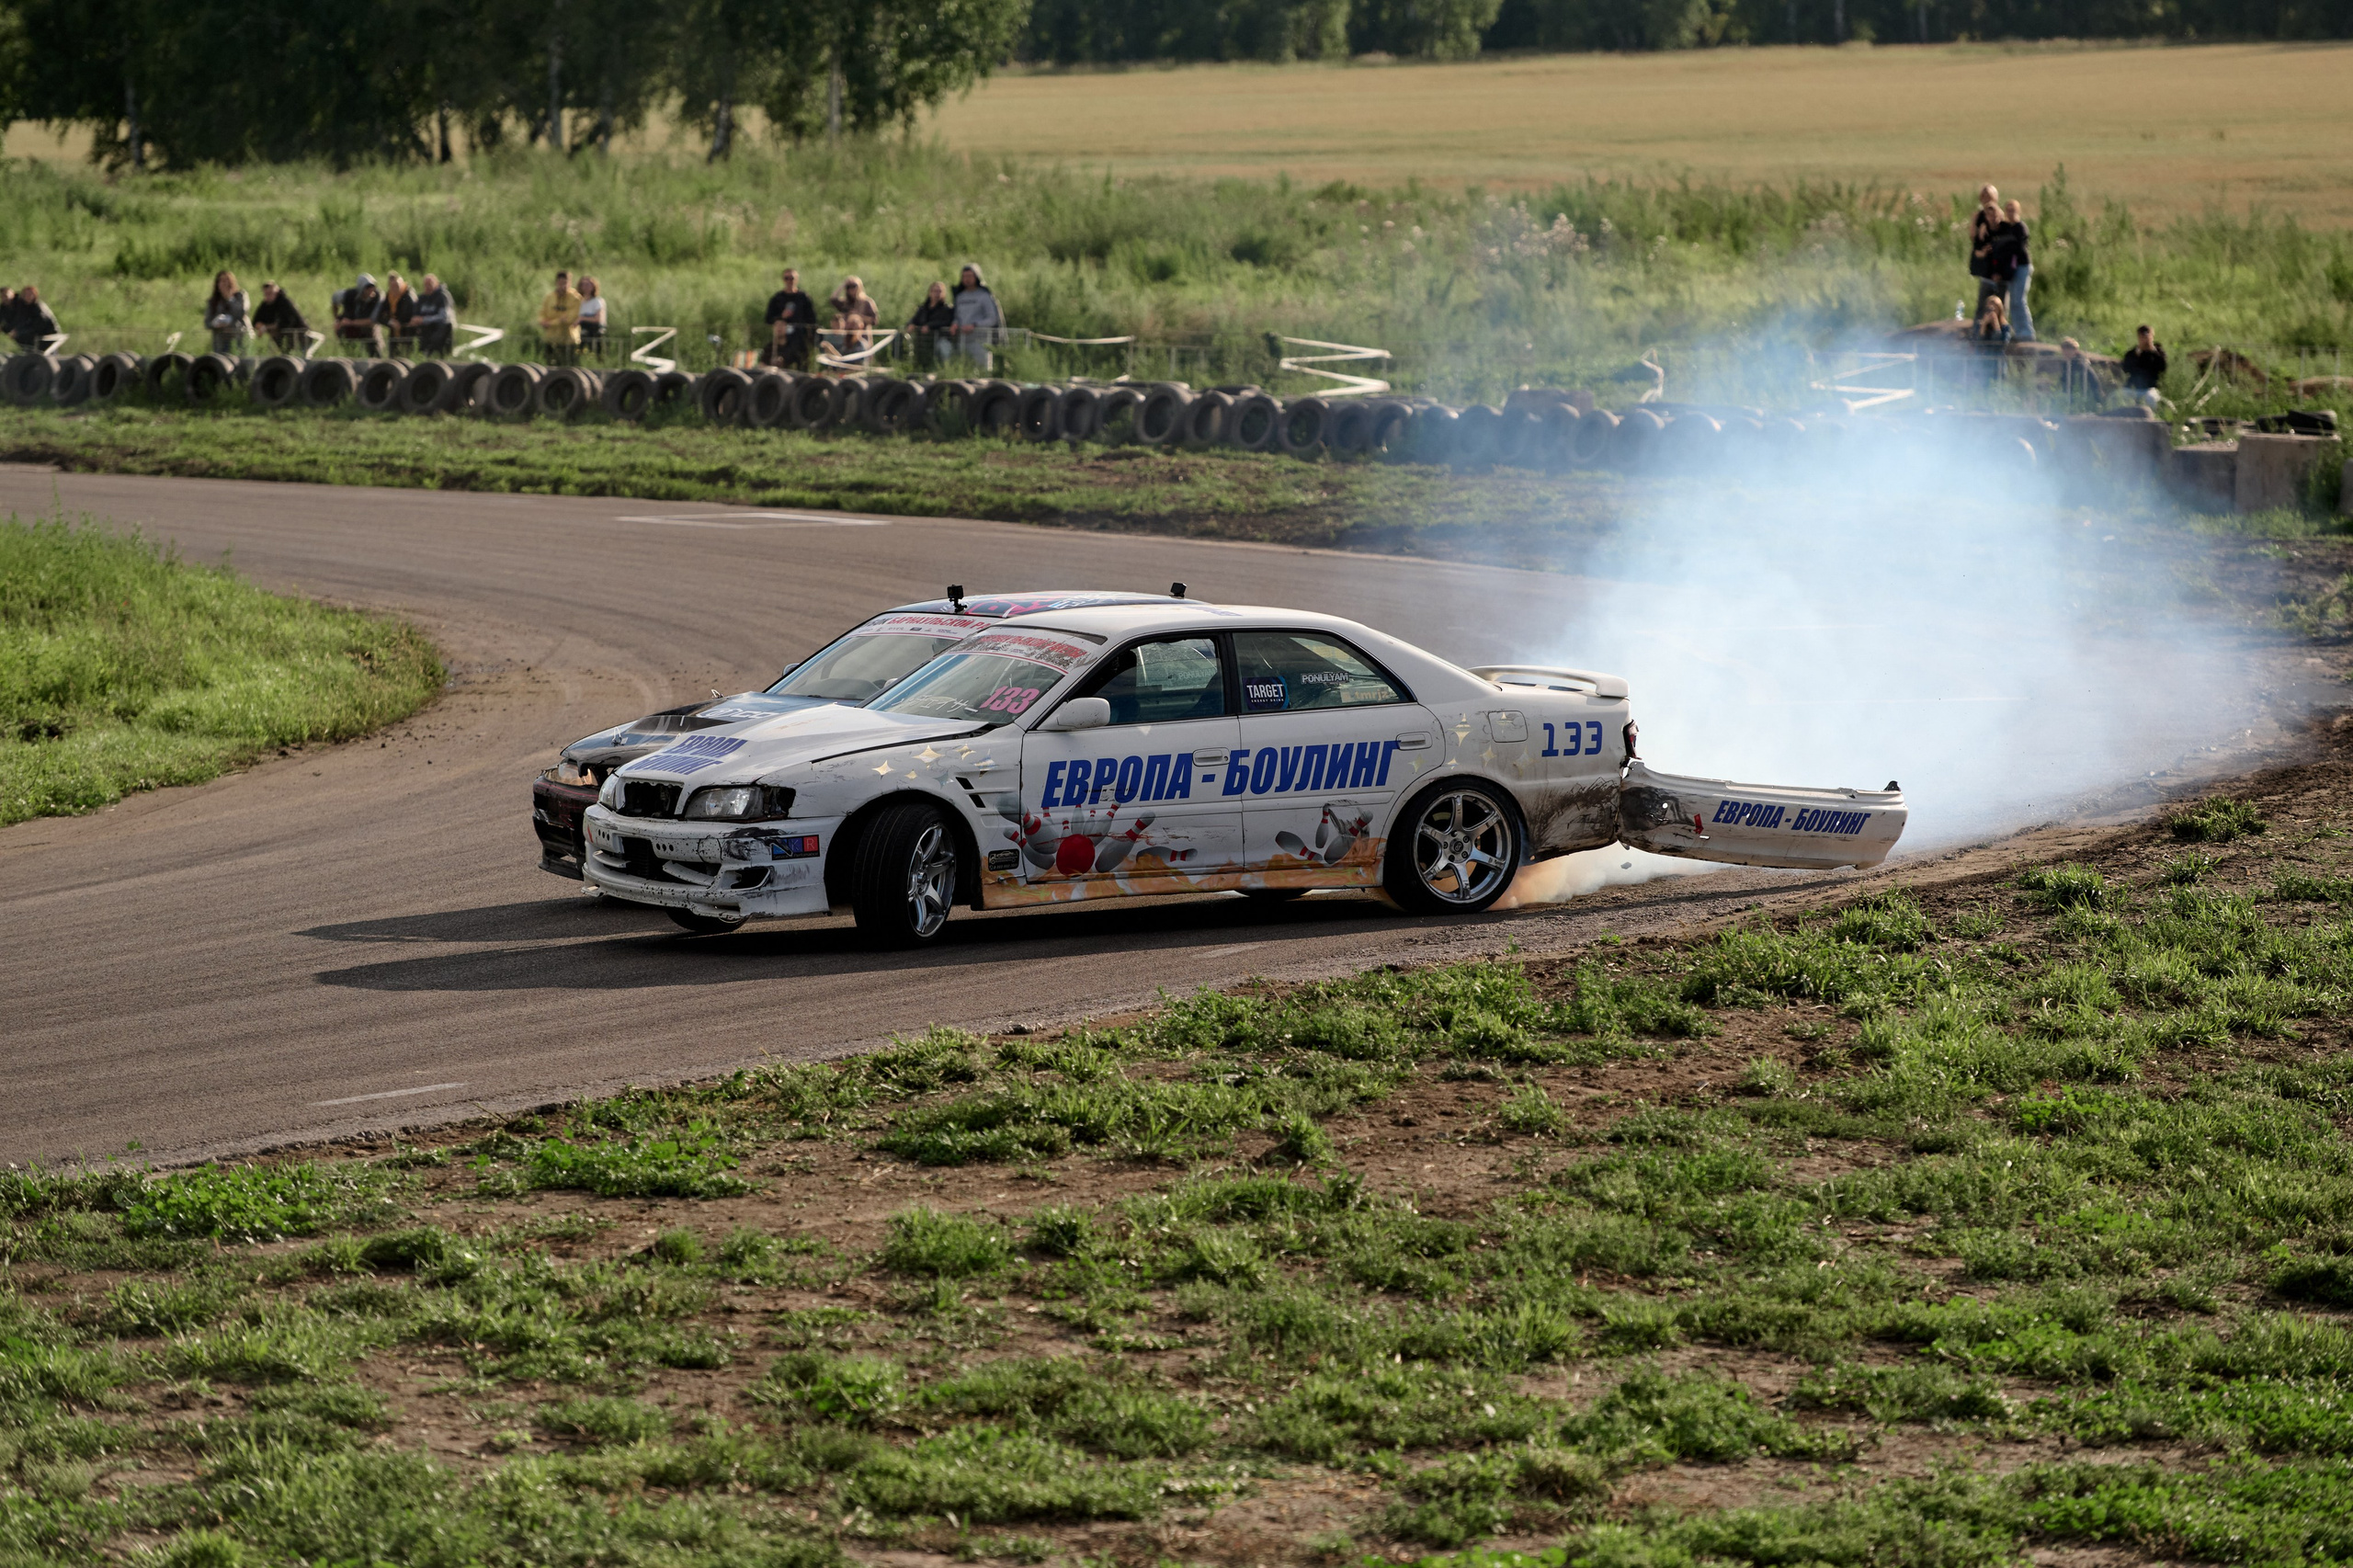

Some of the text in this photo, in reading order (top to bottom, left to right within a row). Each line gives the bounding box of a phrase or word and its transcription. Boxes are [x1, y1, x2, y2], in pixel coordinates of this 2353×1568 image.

[1246, 684, 1284, 699] TARGET
[1301, 672, 1350, 684] PONULYAM
[980, 686, 1040, 714] 133
[1541, 721, 1603, 757] 133
[1040, 753, 1194, 808] ЕВРОПА
[1222, 740, 1402, 797] БОУЛИНГ
[1712, 800, 1786, 829] ЕВРОПА
[1791, 808, 1872, 835] БОУЛИНГ
